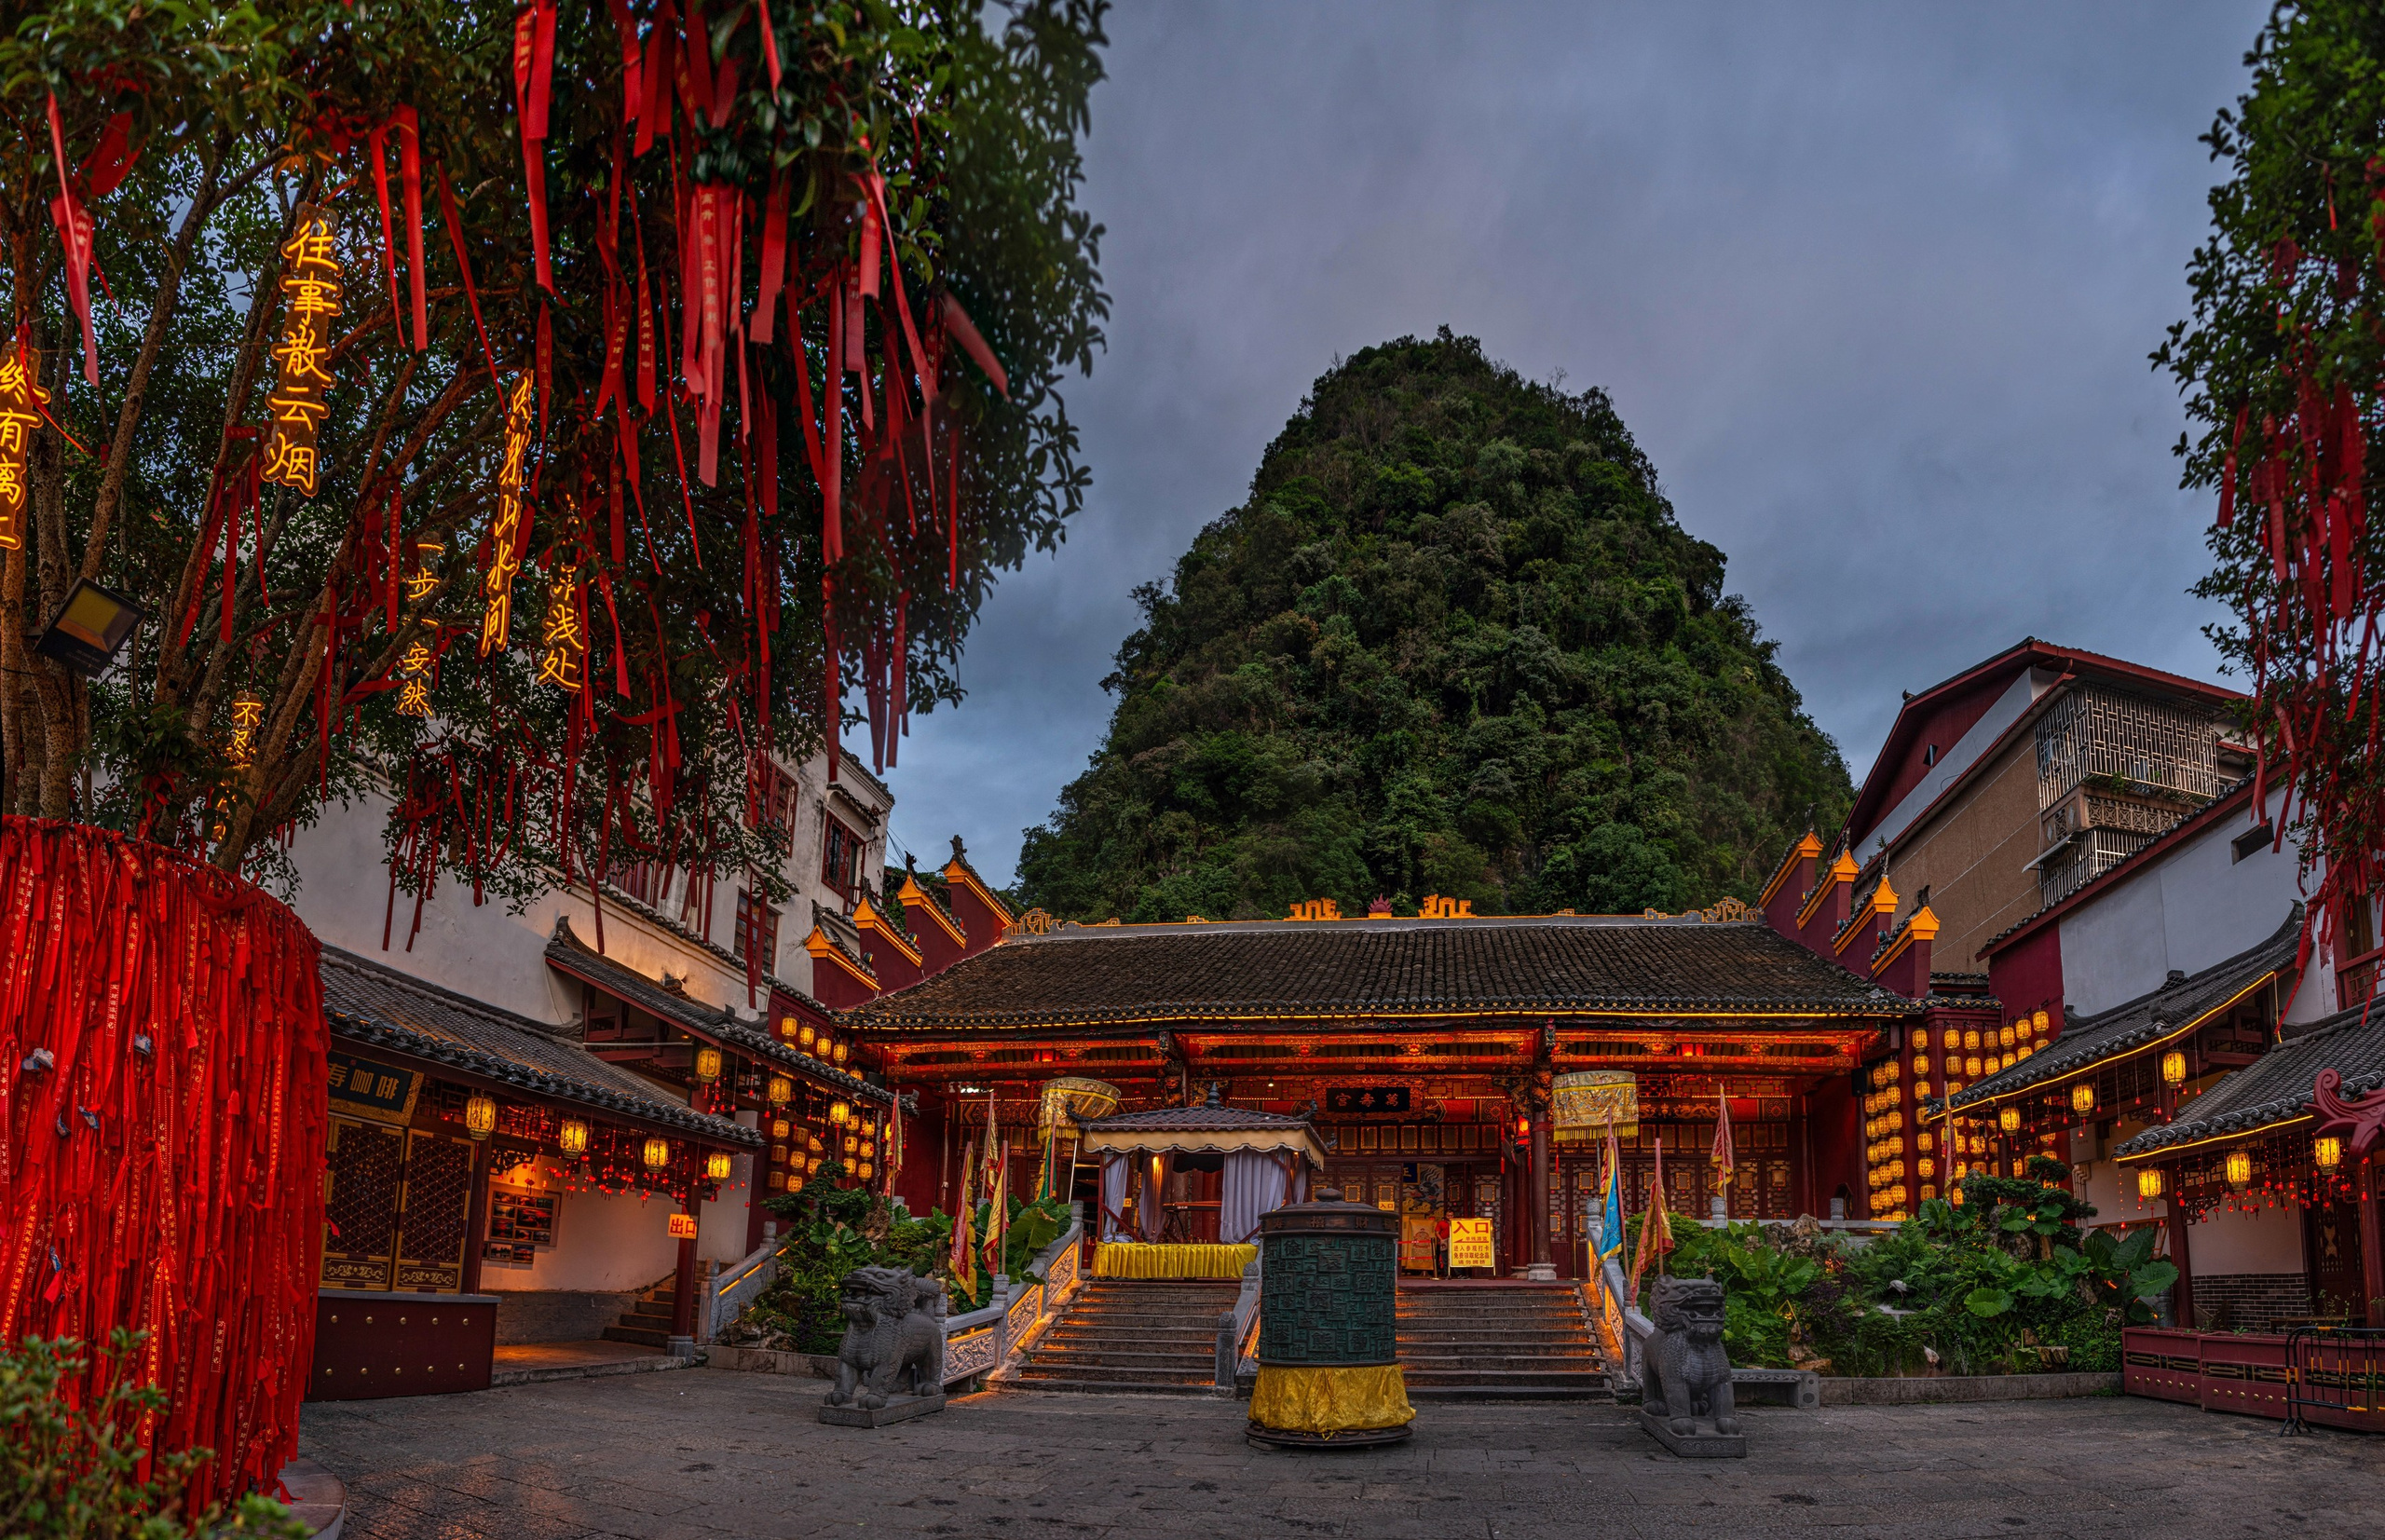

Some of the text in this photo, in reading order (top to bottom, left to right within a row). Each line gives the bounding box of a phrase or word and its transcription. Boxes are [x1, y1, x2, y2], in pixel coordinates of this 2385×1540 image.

[266, 218, 339, 490] 往事散云烟
[670, 1218, 696, 1234] 出口
[1453, 1221, 1489, 1233] 入口
